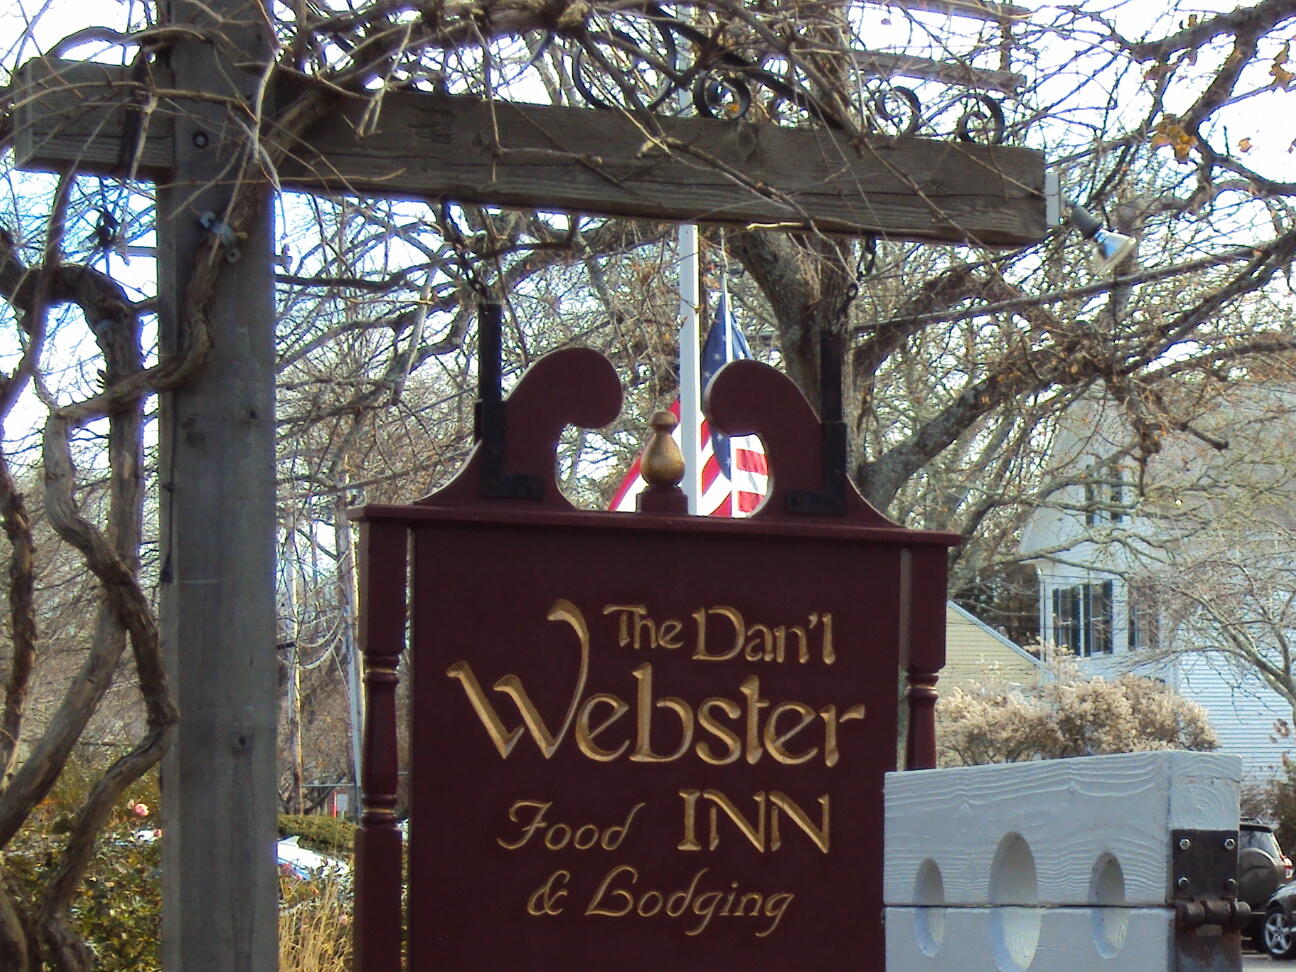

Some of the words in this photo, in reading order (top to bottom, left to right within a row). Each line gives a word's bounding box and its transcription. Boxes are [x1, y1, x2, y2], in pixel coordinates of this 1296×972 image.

[603, 604, 684, 649] The
[692, 605, 836, 664] Dan'l
[447, 599, 866, 767] Webster
[496, 801, 646, 851] Food
[676, 789, 830, 854] INN
[527, 870, 571, 917] &
[584, 865, 794, 937] Lodging
